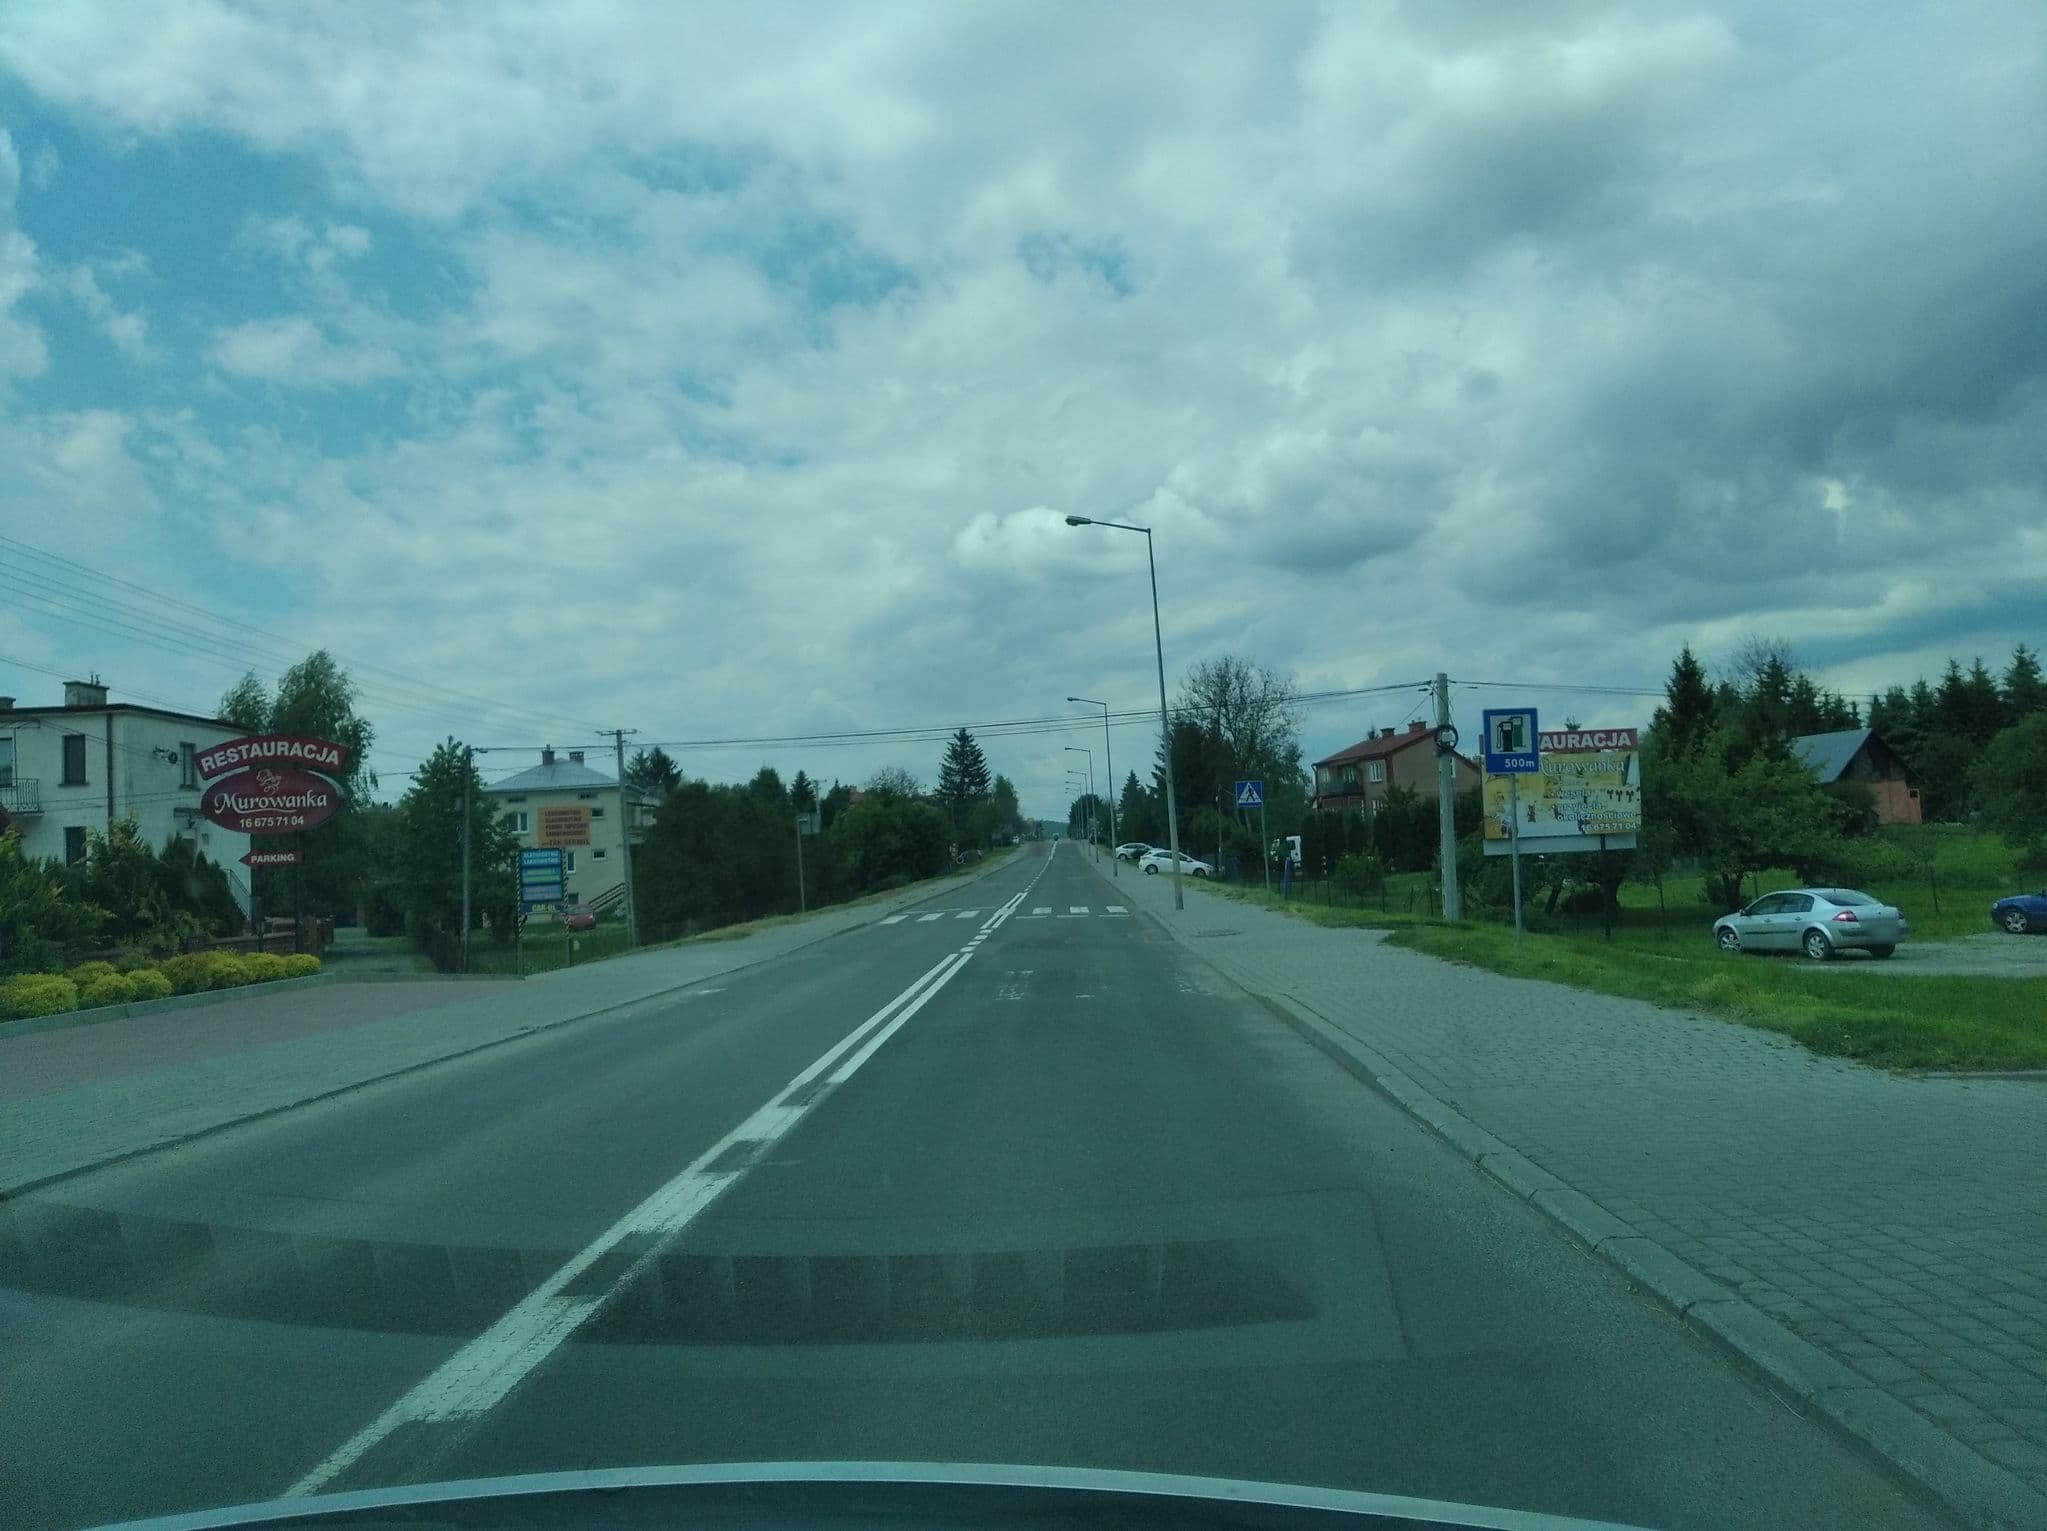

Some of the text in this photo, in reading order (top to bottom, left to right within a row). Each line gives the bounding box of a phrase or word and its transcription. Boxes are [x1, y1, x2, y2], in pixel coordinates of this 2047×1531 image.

[1540, 732, 1632, 750] AURACJA
[201, 742, 340, 772] RESTAURACJA
[1504, 758, 1535, 768] 500m
[214, 789, 327, 814] Murowanka
[240, 815, 304, 829] 16 675 71 04
[1594, 822, 1610, 831] 675
[1612, 822, 1622, 830] 71
[1625, 822, 1636, 830] 04
[250, 853, 295, 864] PARKING
